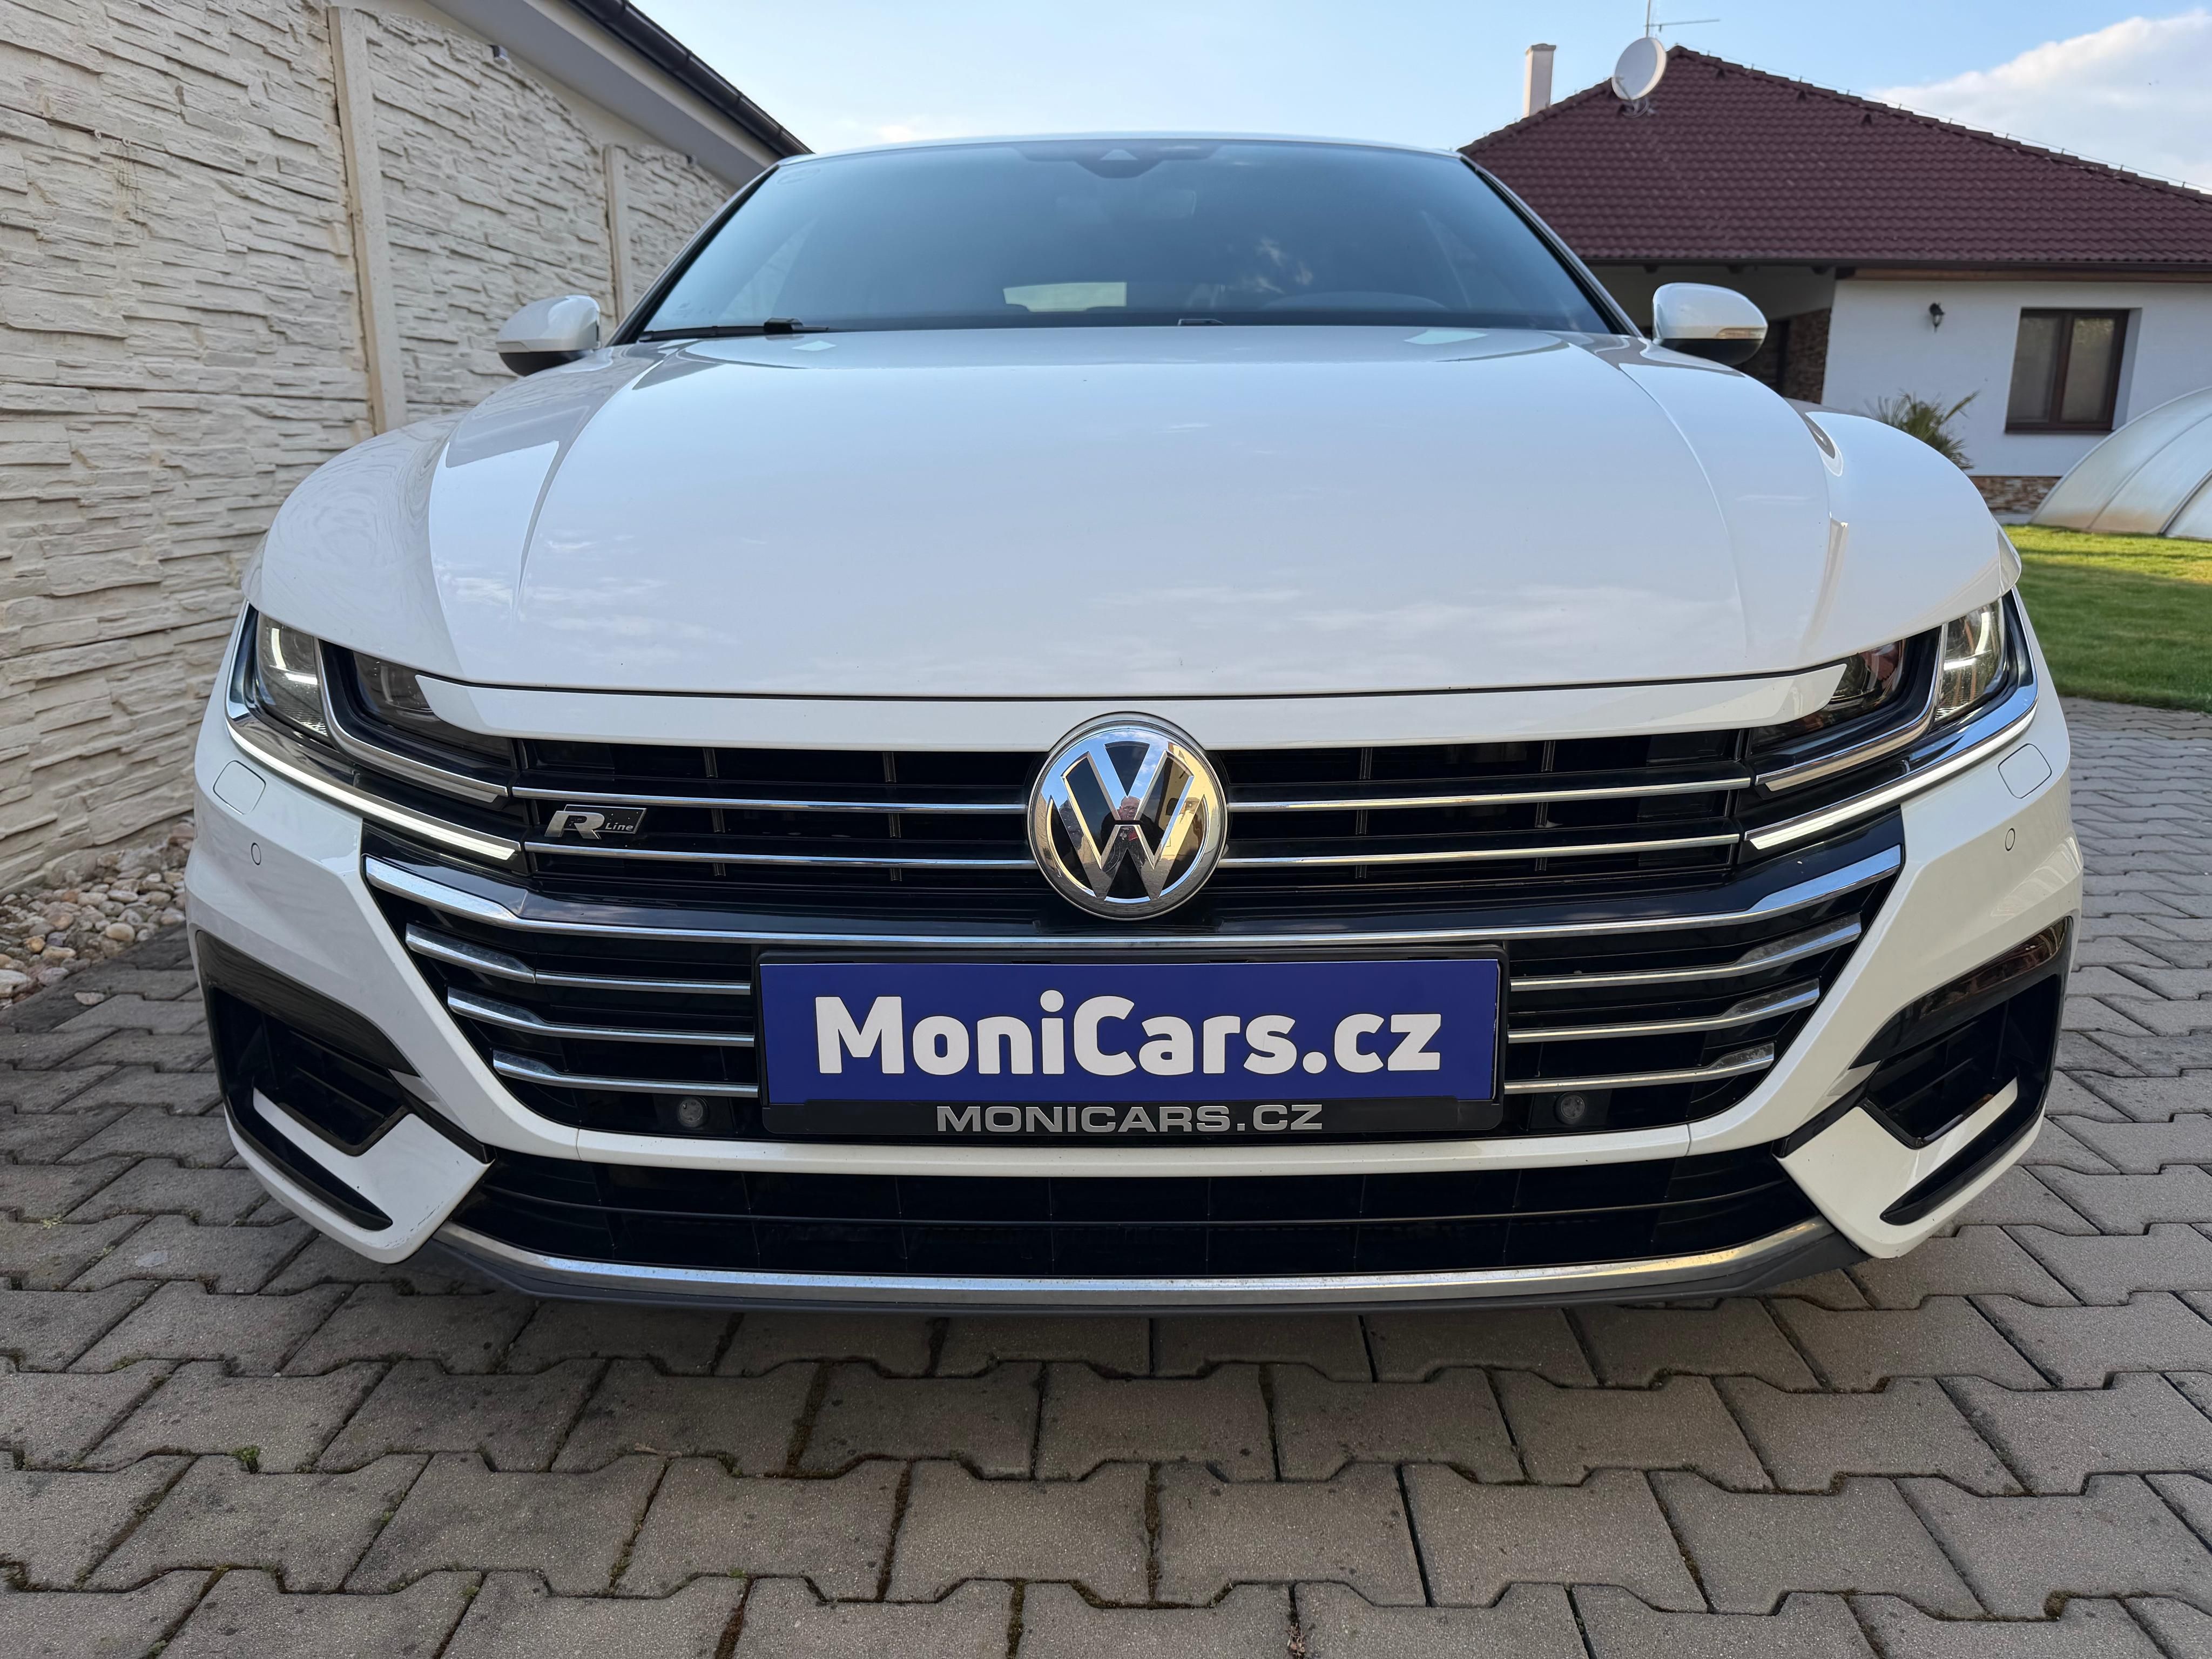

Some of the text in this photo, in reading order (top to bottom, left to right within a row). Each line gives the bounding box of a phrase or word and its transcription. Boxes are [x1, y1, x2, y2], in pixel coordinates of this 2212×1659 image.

[544, 810, 634, 839] R Line
[1038, 728, 1216, 907] VW
[814, 989, 1442, 1076] MoniCars.cz
[936, 1104, 1323, 1133] MONICARS.CZ
